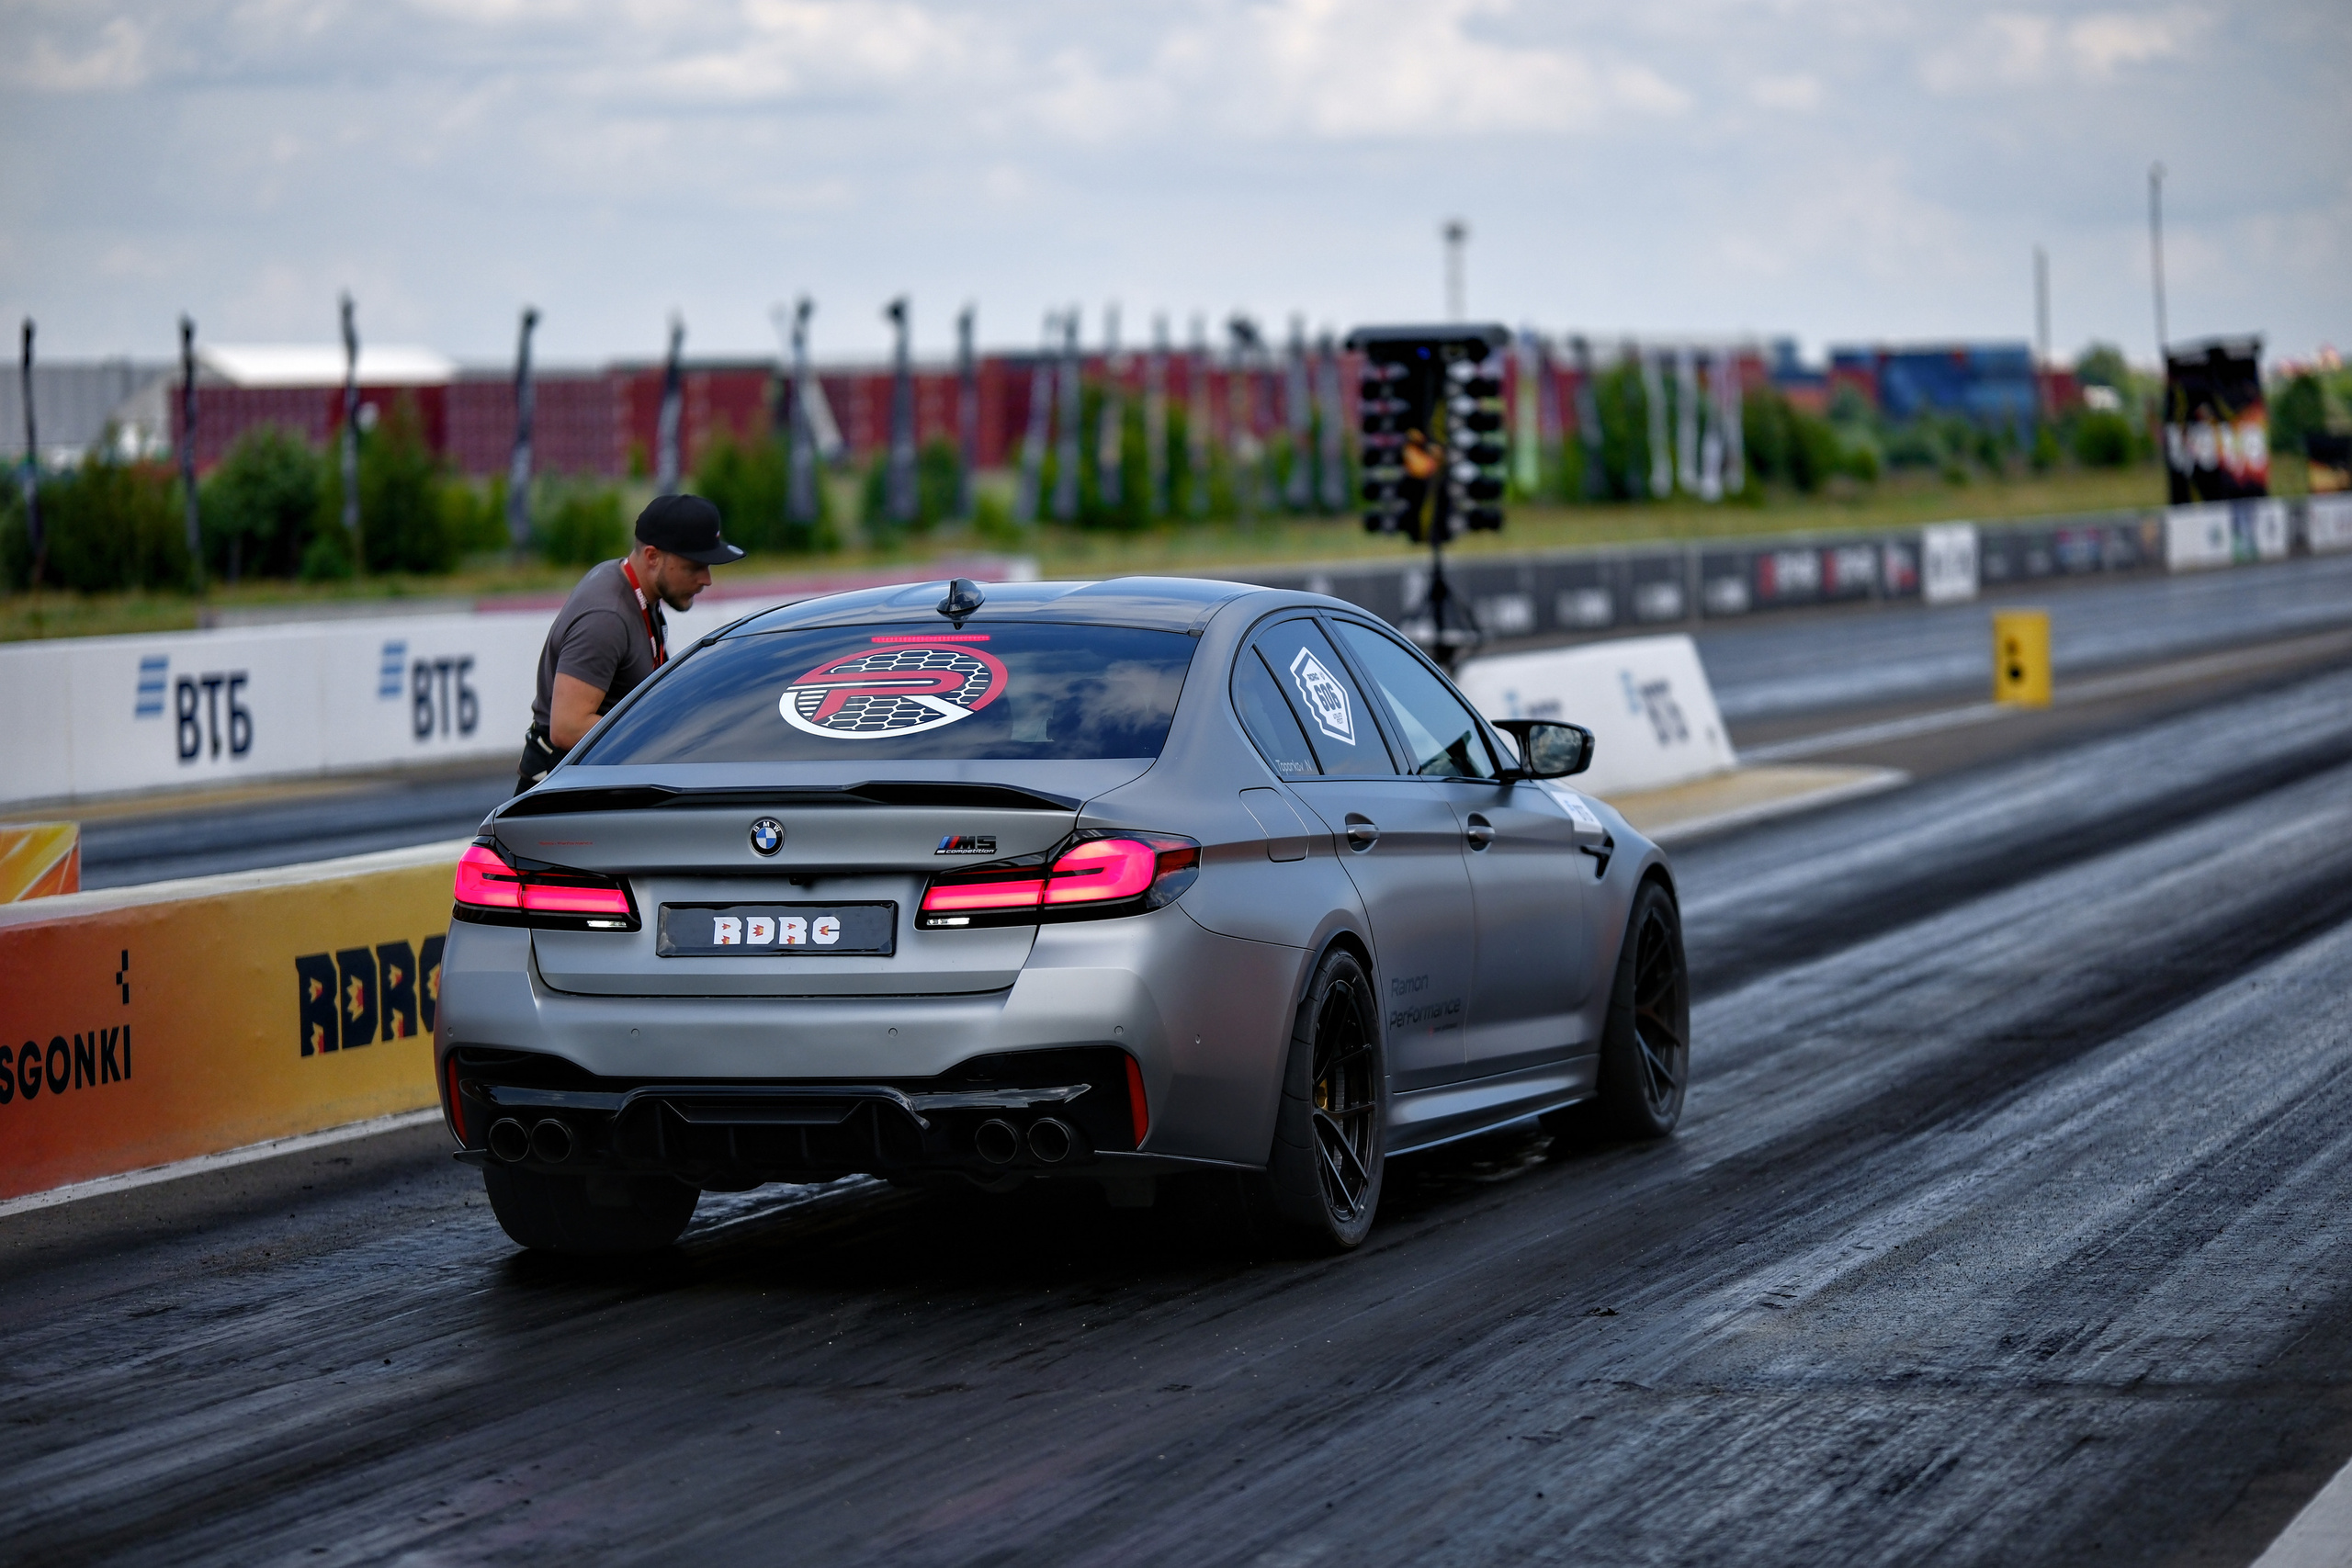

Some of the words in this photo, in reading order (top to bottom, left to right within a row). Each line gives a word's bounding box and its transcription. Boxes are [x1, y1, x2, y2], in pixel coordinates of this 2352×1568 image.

[411, 655, 481, 742] ВТБ
[1313, 682, 1342, 712] 606
[175, 670, 254, 764] ВТБ
[752, 820, 782, 833] BMW
[950, 835, 997, 850] M5
[713, 916, 841, 945] RDRC
[1391, 975, 1429, 998] Ramon
